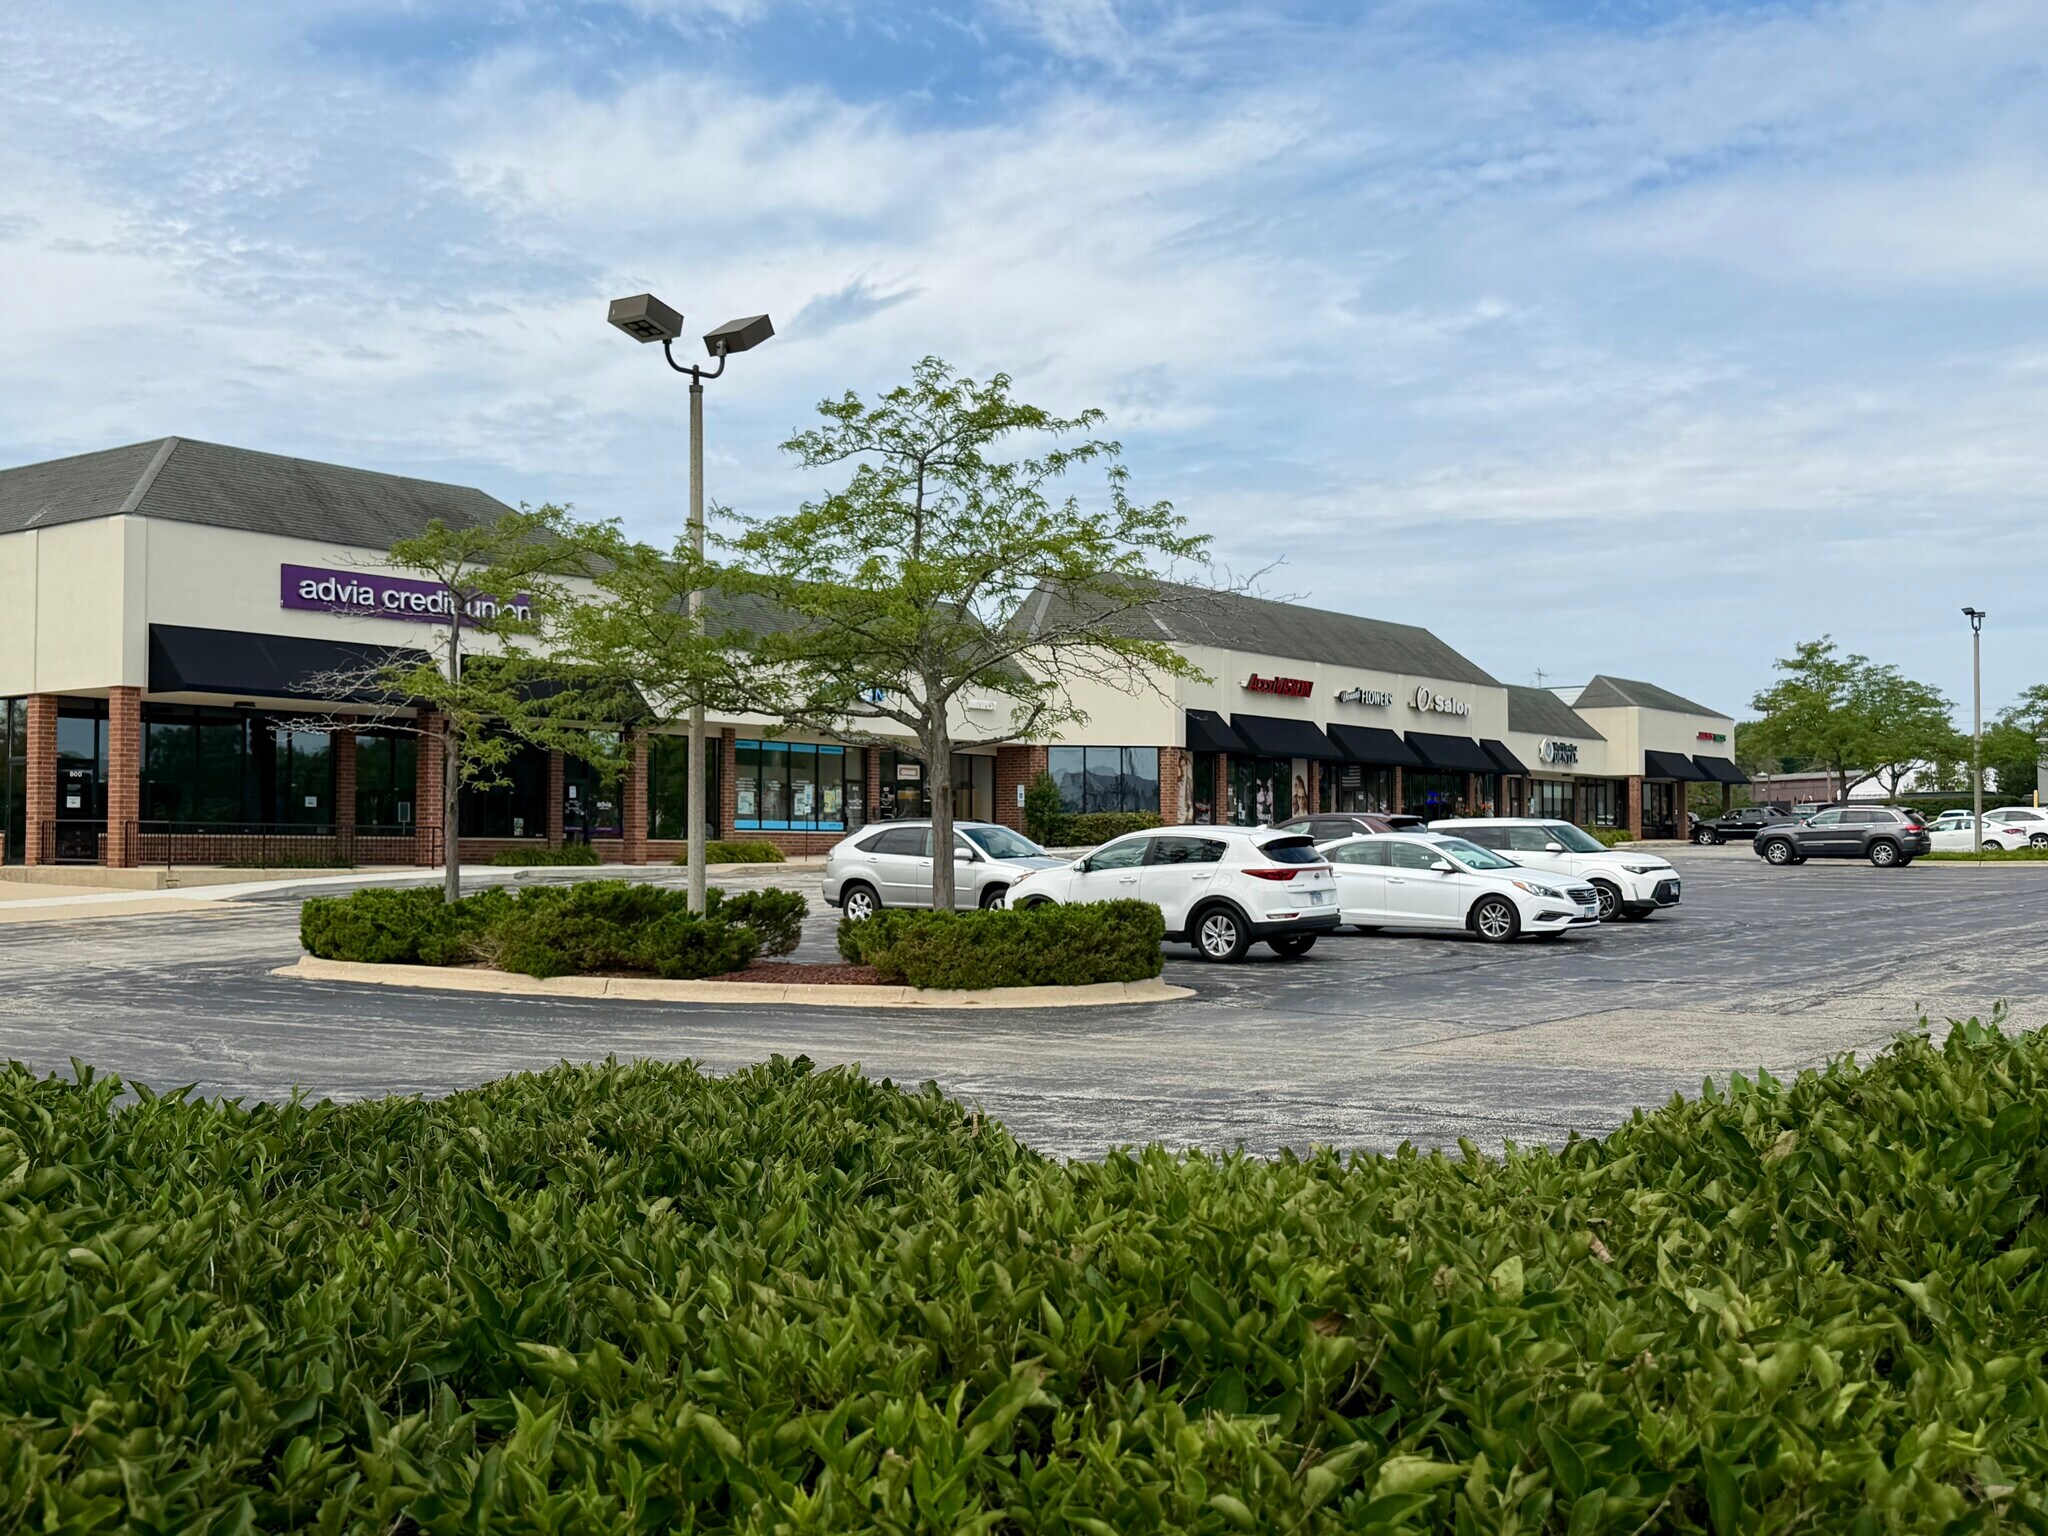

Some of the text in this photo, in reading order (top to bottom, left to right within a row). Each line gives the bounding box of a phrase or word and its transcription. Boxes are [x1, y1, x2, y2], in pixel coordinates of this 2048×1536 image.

[299, 577, 374, 606] advia
[1360, 690, 1393, 706] FLOWERS
[1433, 694, 1473, 716] Salon
